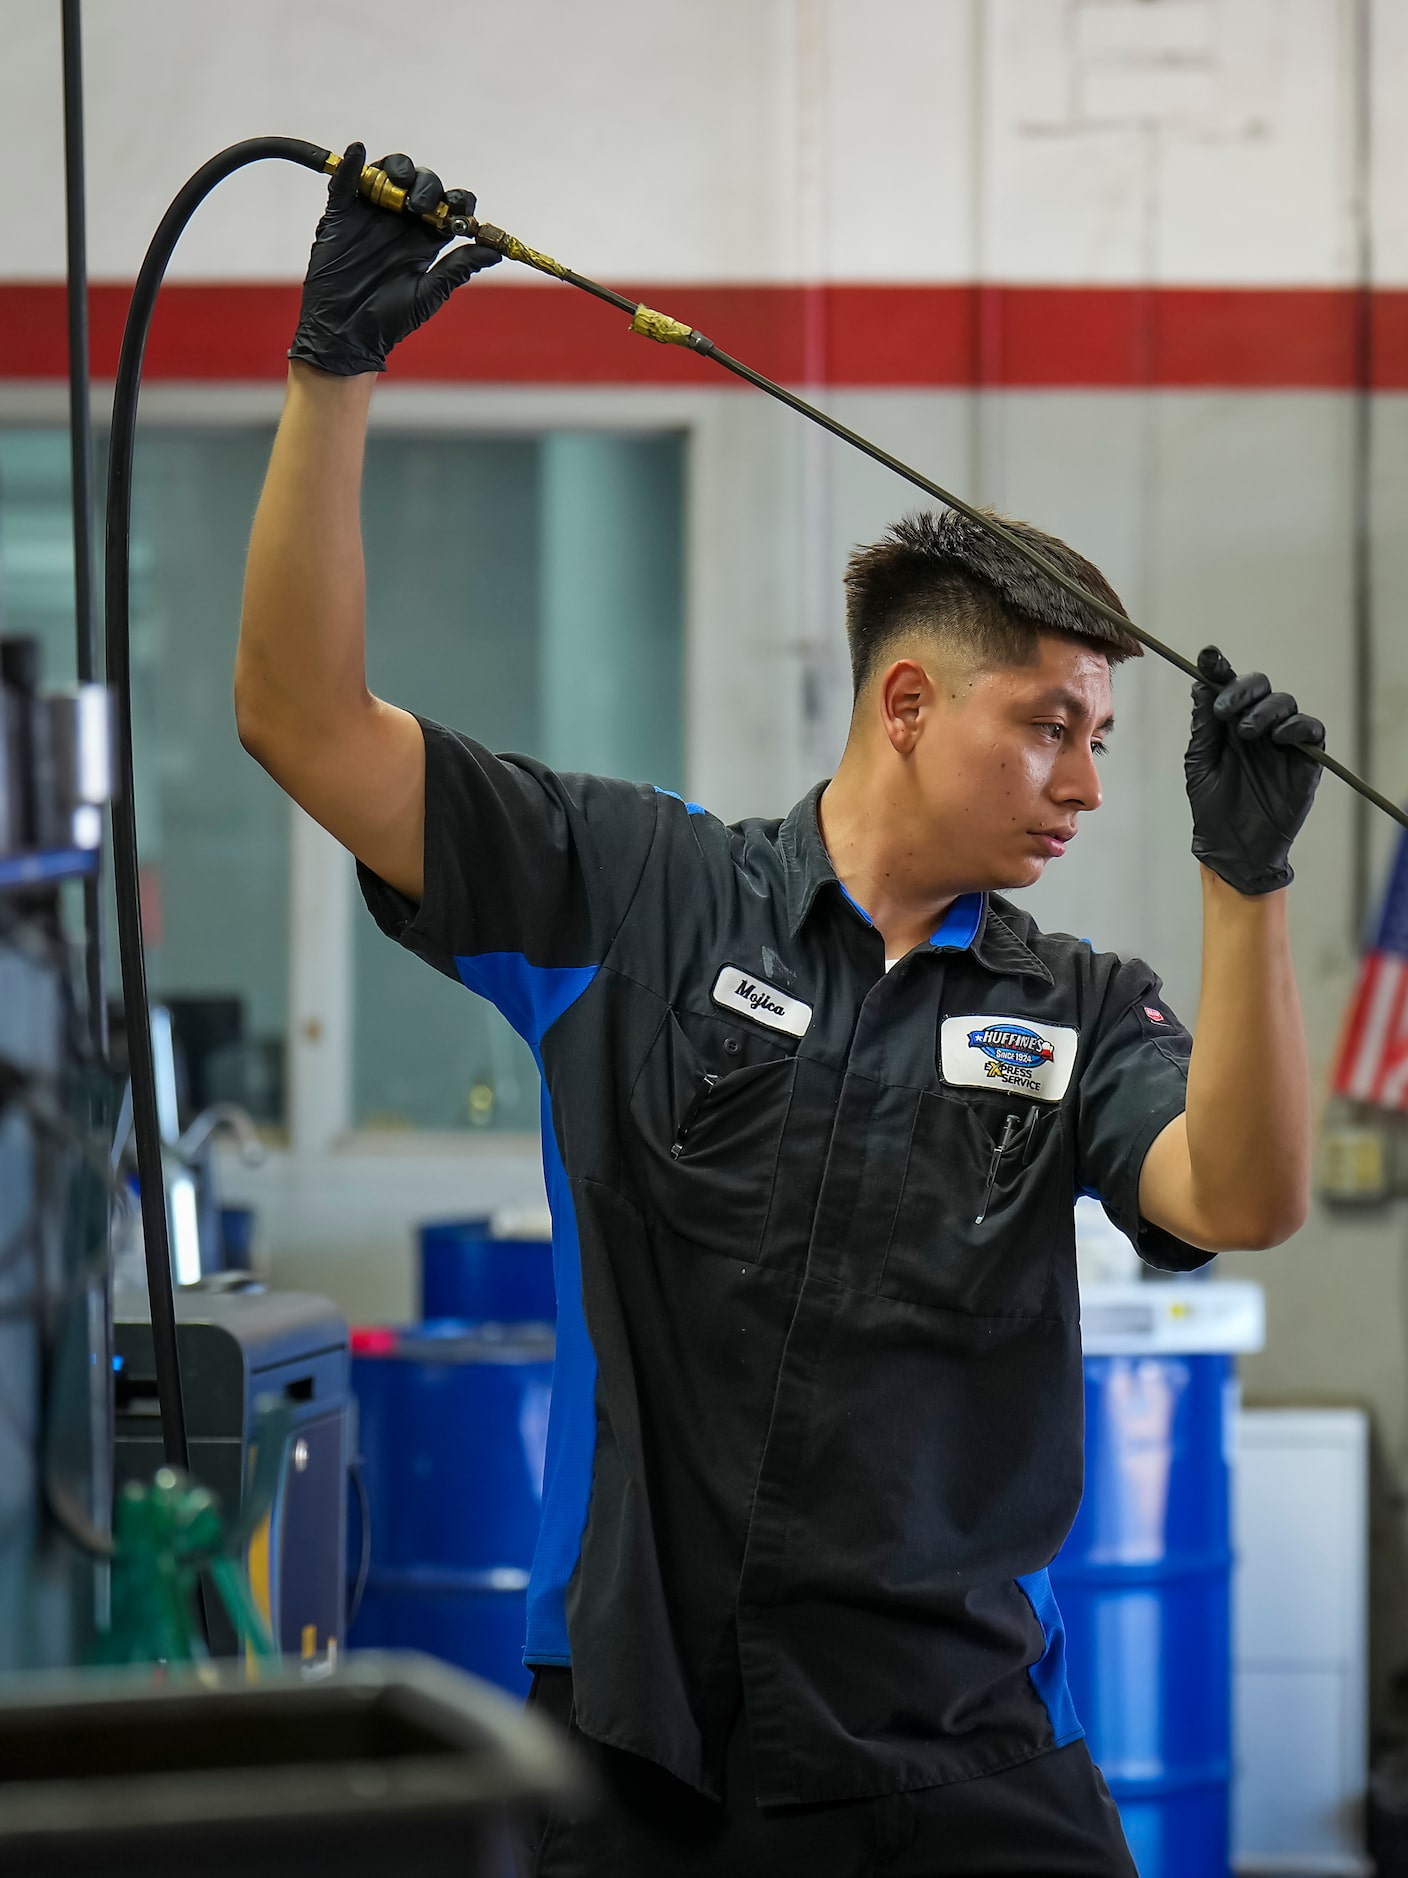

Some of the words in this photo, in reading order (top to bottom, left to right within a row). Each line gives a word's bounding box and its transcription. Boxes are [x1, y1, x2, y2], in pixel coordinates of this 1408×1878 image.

[734, 979, 785, 1016] Mojica
[983, 1030, 1044, 1052] HUFFINES
[1015, 1051, 1033, 1063] 1924
[984, 1061, 1033, 1078] EXPRESS
[1001, 1073, 1041, 1091] SERVICE
